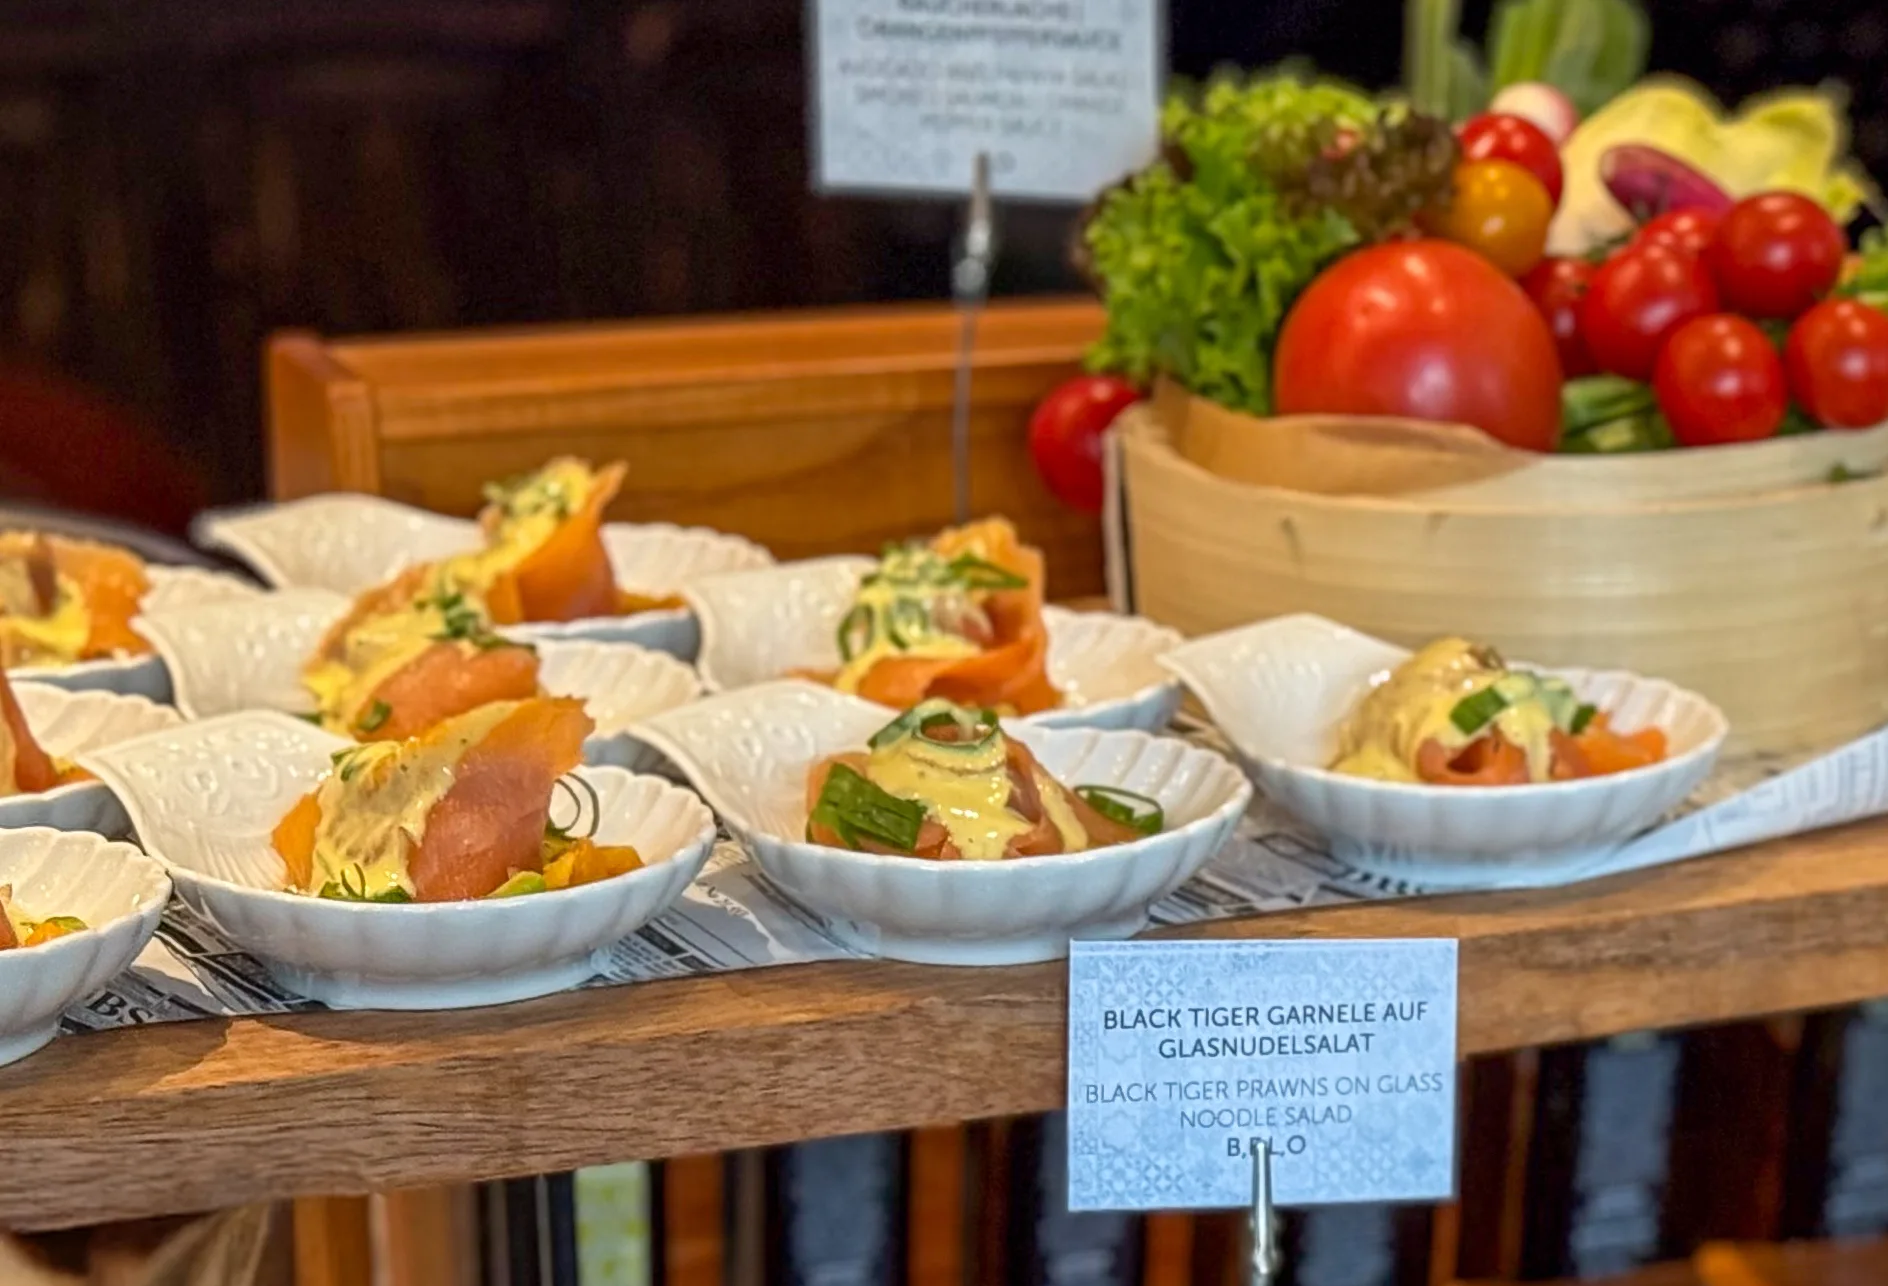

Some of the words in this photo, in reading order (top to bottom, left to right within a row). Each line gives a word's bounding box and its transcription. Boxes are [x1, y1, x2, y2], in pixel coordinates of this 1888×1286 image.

[86, 992, 153, 1024] BS
[1104, 1008, 1182, 1030] BLACK
[1192, 1006, 1260, 1028] TIGER
[1267, 1003, 1376, 1026] GARNELE
[1383, 1001, 1429, 1023] AUF
[1158, 1032, 1376, 1060] GLASNUDELSALAT
[1086, 1082, 1158, 1104] BLACK
[1164, 1080, 1229, 1100] TIGER
[1236, 1076, 1328, 1099] PRAWNS
[1335, 1074, 1371, 1095] ON
[1378, 1072, 1443, 1094] GLASS
[1180, 1108, 1277, 1129] NOODLE
[1284, 1105, 1352, 1127] SALAD
